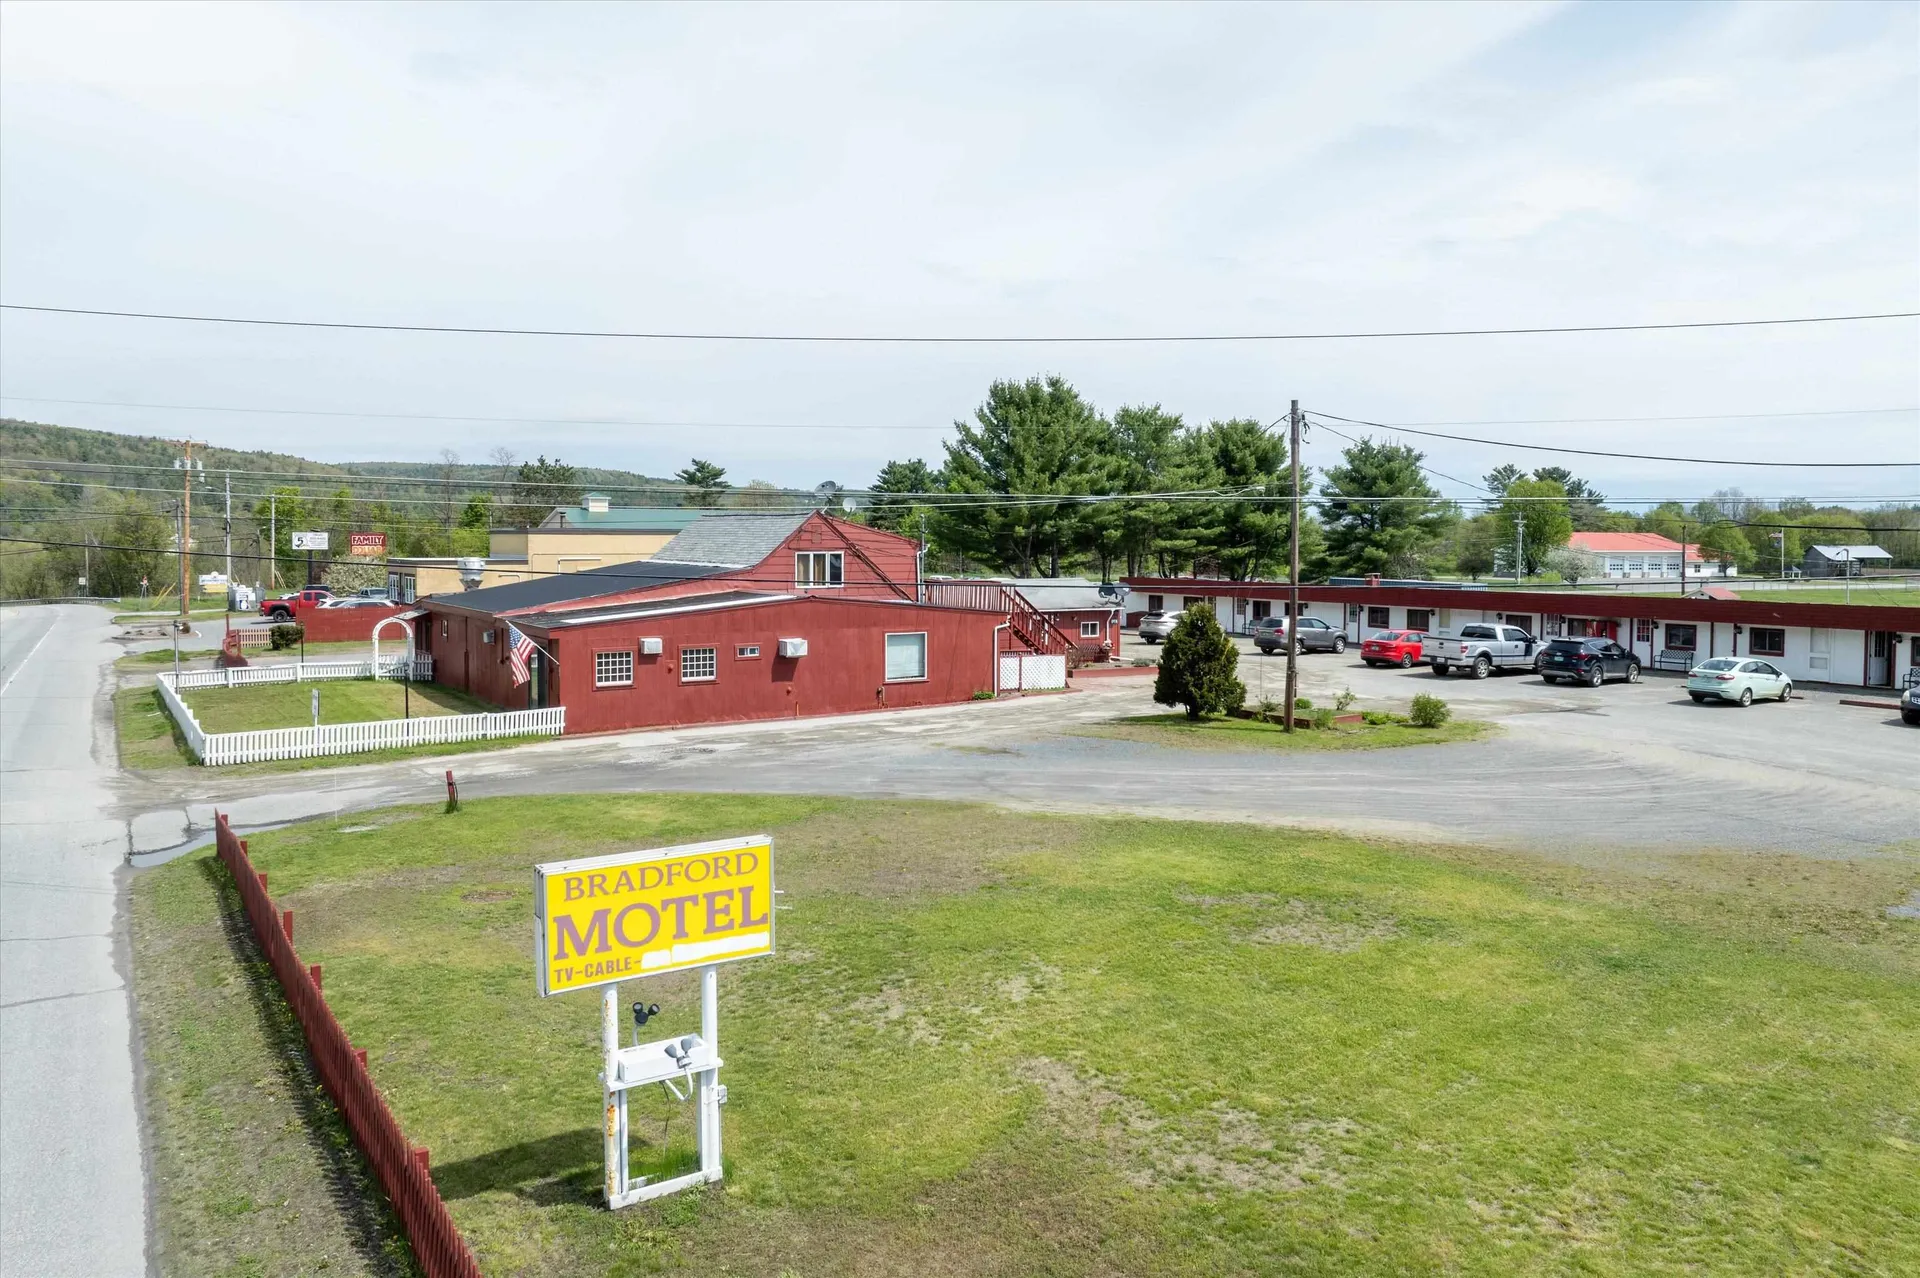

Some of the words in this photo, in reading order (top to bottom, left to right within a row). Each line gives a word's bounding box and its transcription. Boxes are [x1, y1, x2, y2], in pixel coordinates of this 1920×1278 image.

[351, 535, 384, 545] FAMILY
[564, 852, 758, 902] BRADFORD
[553, 886, 768, 961] MOTEL
